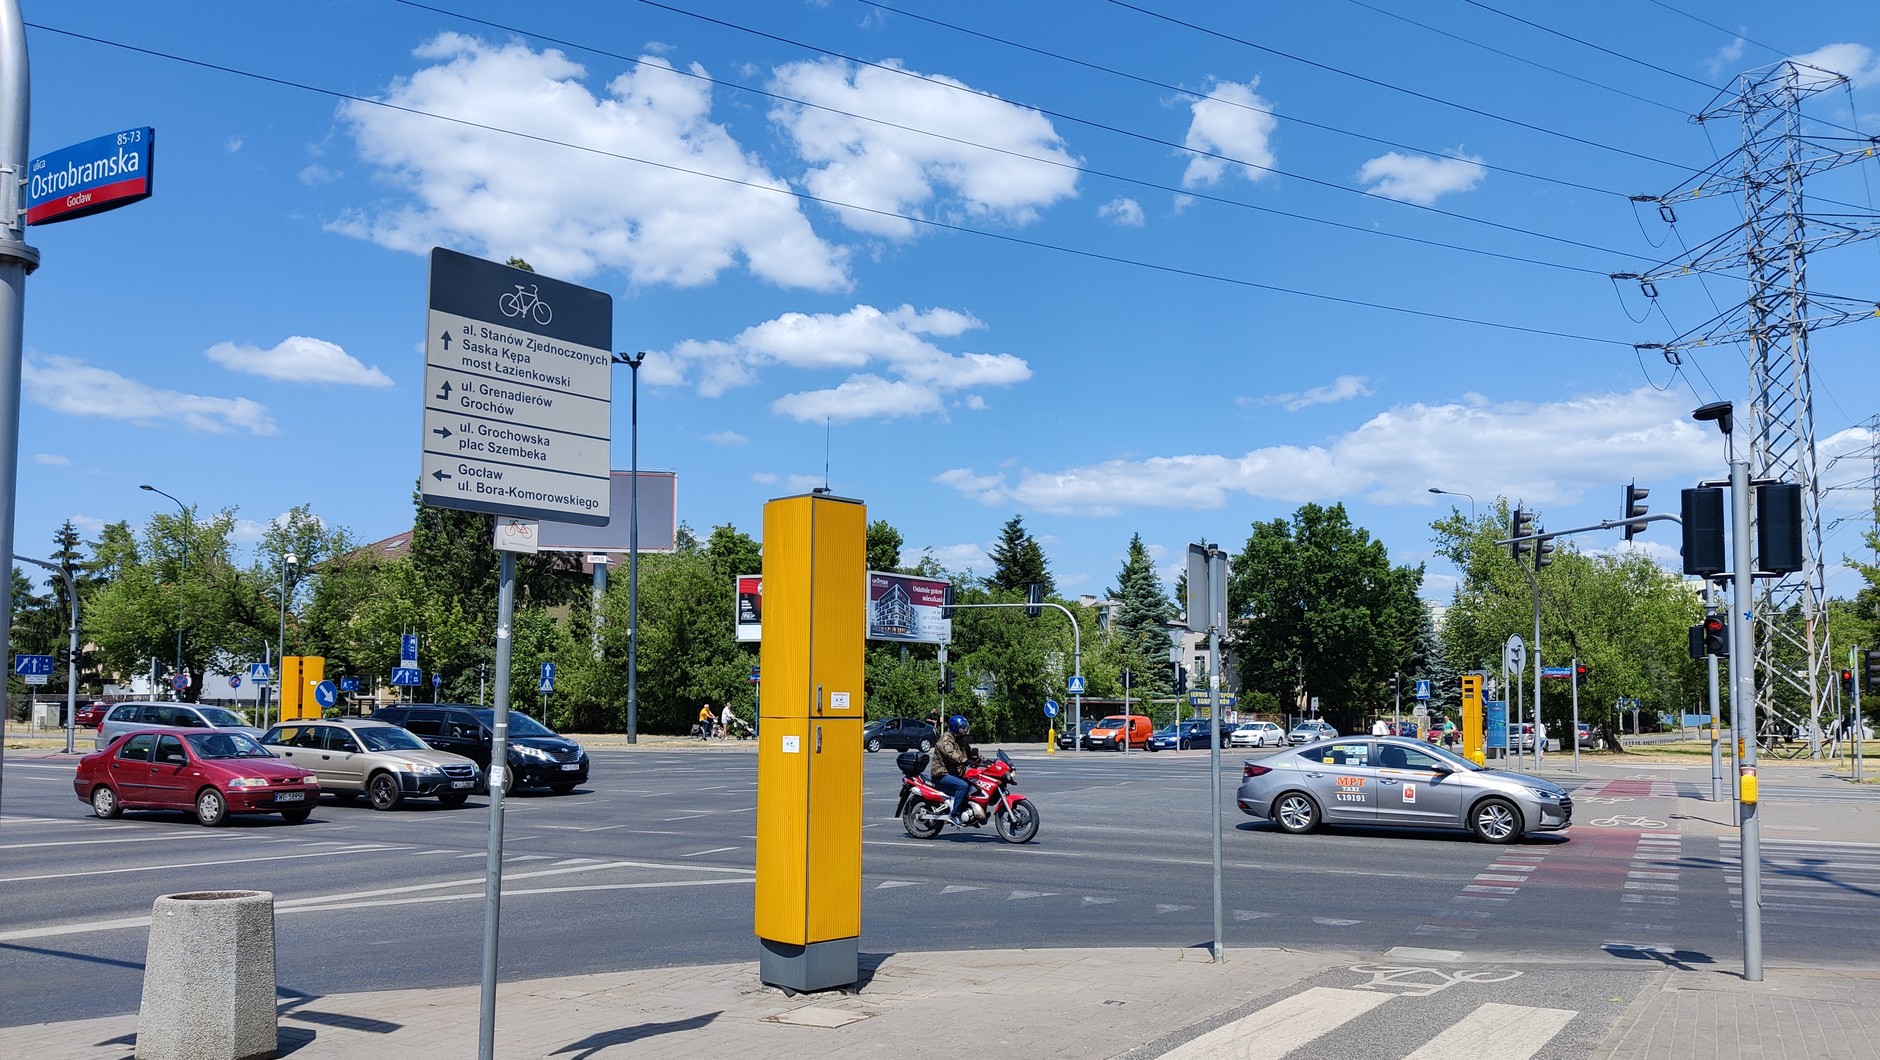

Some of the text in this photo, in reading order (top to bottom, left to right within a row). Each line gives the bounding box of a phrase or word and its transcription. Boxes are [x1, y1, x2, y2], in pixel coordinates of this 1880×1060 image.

[117, 130, 141, 146] 85-73
[31, 147, 139, 200] Ostrobramska
[32, 157, 46, 172] ulica
[462, 324, 608, 366] al. Stanów Zjednoczonych
[462, 339, 531, 364] Saska Kępa
[461, 356, 571, 388] most Łazienkowski
[460, 395, 515, 416] Grochów
[461, 381, 553, 408] ul. Grenadierów
[459, 422, 550, 447] ul. Grochowska
[458, 438, 547, 461] plac Szembeka
[458, 463, 503, 480] Gocław
[458, 480, 599, 510] ul. Bora-Komorowskiego
[1336, 776, 1365, 787] MPT
[1342, 794, 1366, 802] 19191
